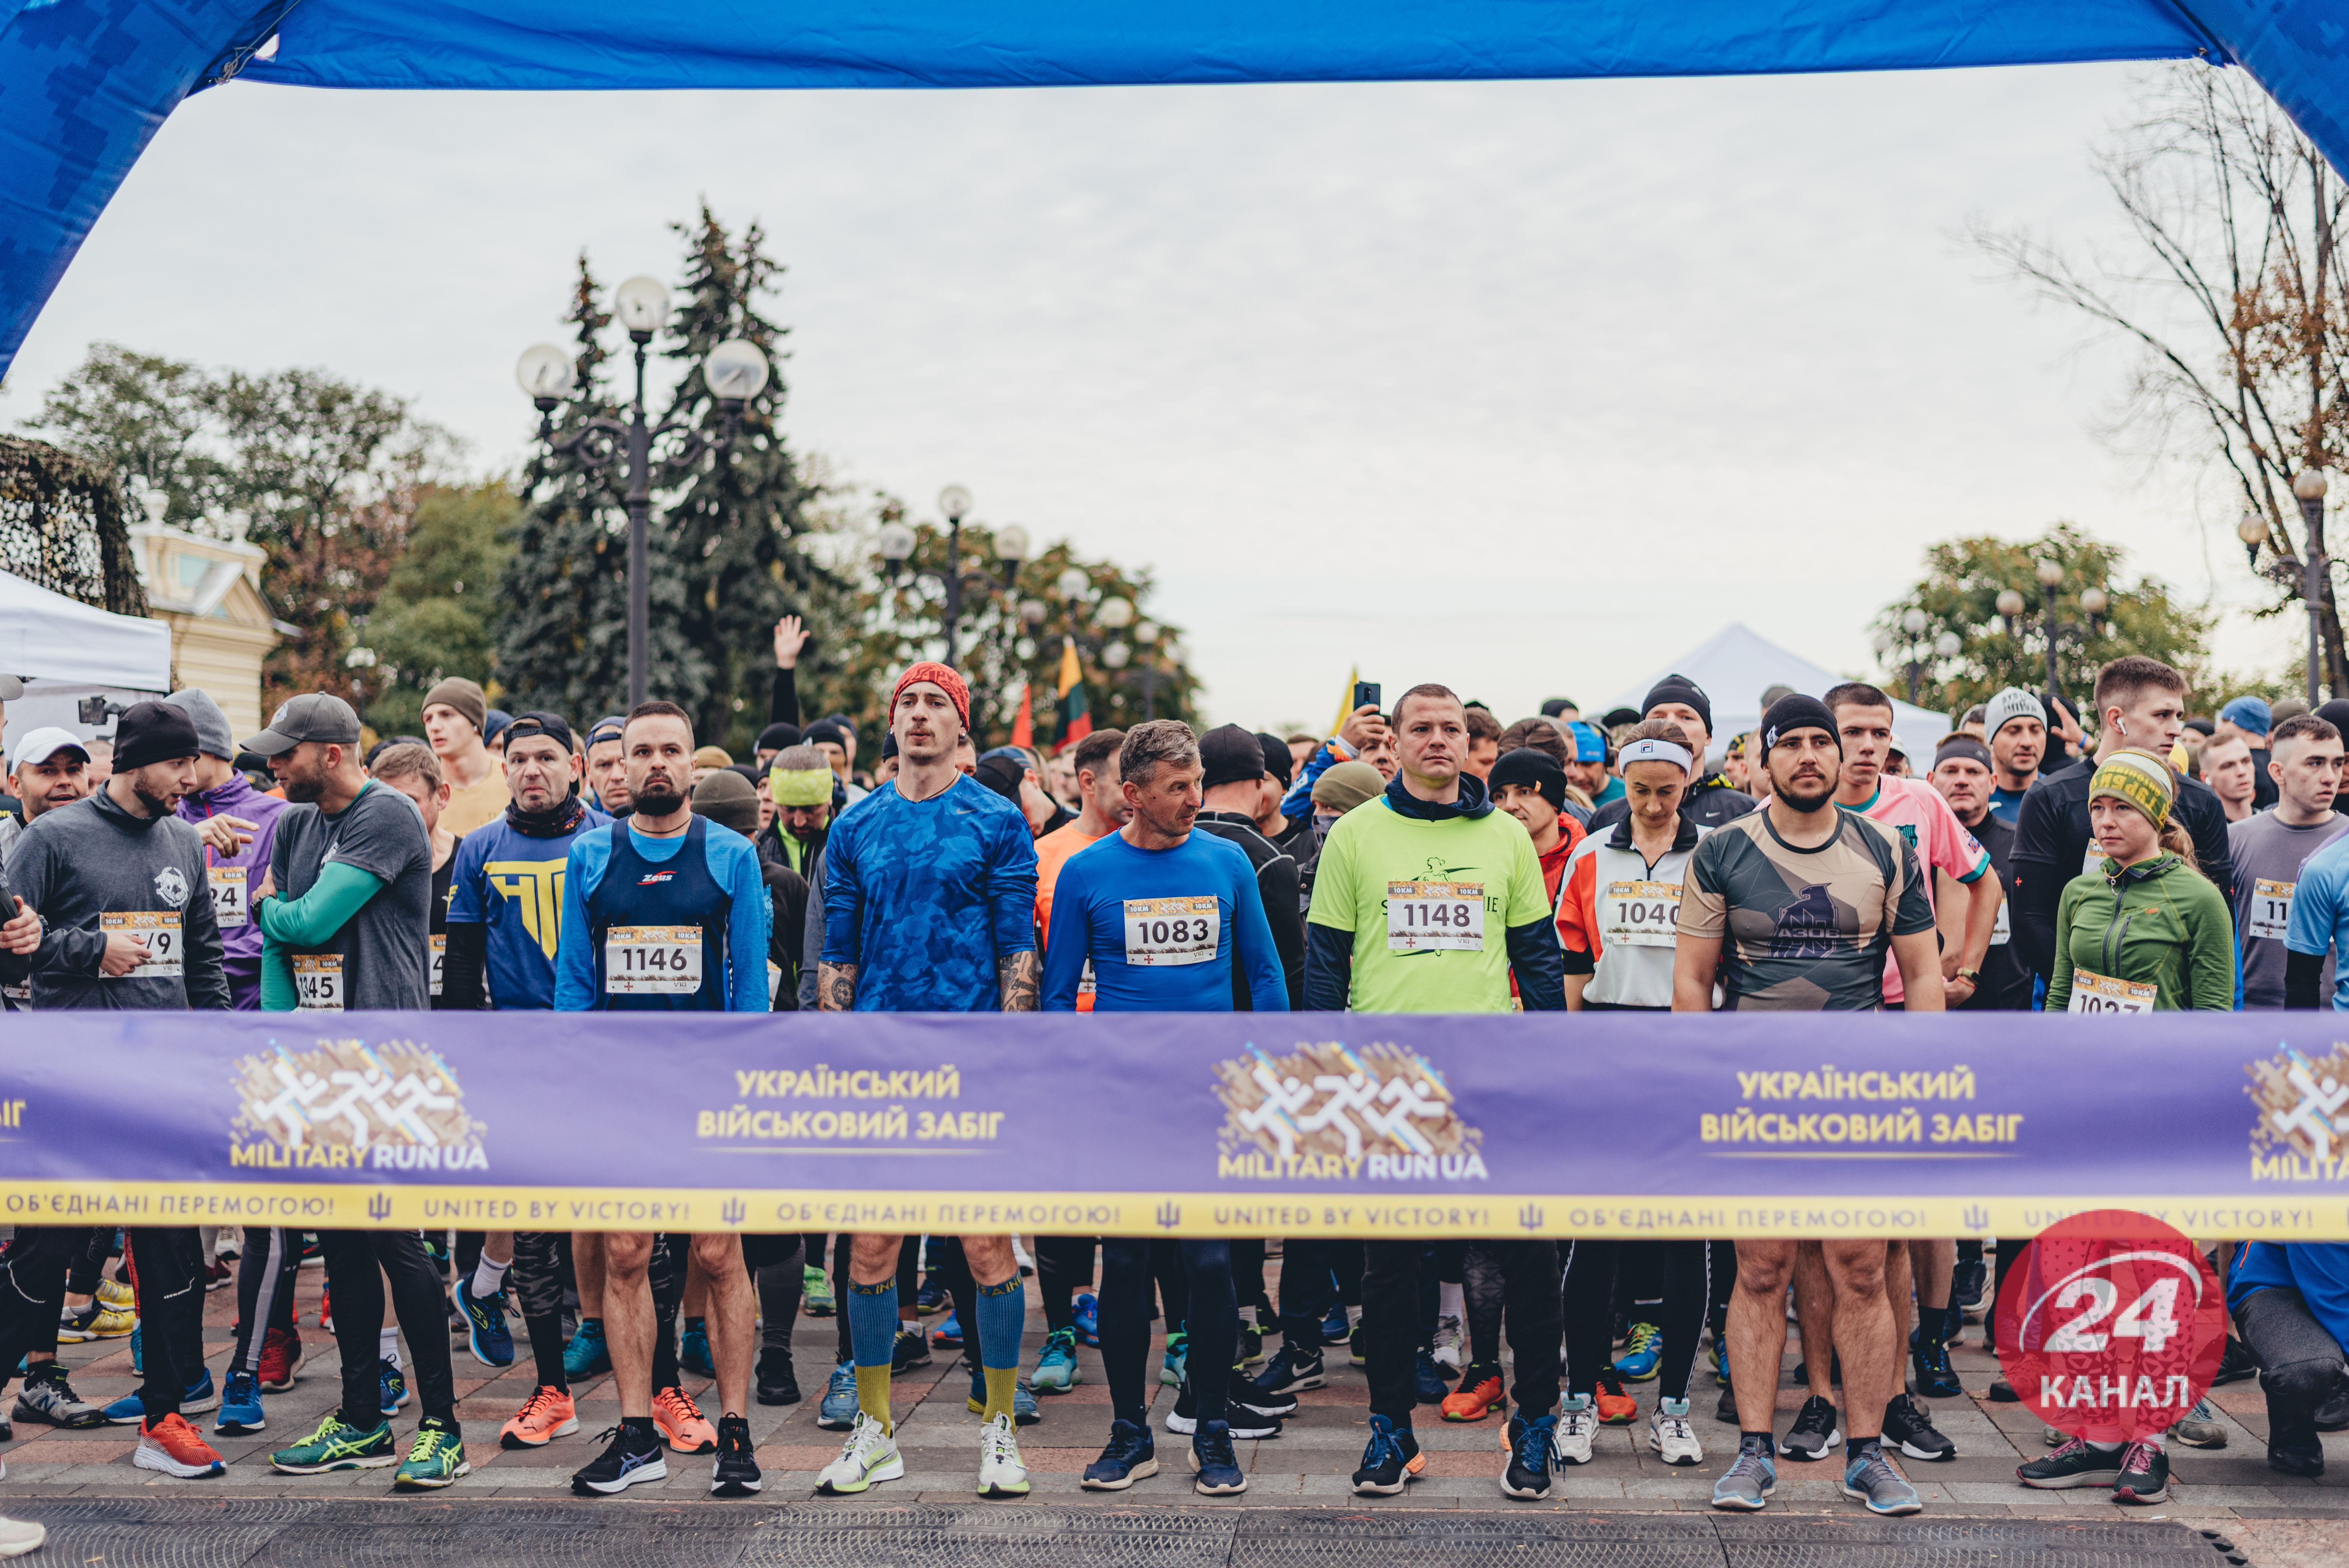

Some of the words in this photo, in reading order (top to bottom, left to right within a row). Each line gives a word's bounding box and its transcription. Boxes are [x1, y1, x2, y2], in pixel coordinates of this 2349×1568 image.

[642, 874, 673, 882] Zeus
[1404, 904, 1470, 927] 1148
[1138, 918, 1208, 944] 1083
[1778, 928, 1841, 938] АЗОВ
[622, 948, 687, 970] 1146
[300, 976, 333, 998] 1345
[2079, 976, 2092, 985] 10KM
[735, 1064, 960, 1099] УКРАЇНСЬКИЙ
[1737, 1065, 1975, 1100] УКРАЇНСЬКИЙ
[697, 1104, 908, 1139] ВІЙСЬКОВИЙ
[915, 1111, 1004, 1140] ЗАБІГ
[1701, 1107, 1921, 1143] ВІЙСЬКОВИЙ
[1930, 1114, 2023, 1143] ЗАБІГ
[231, 1144, 369, 1168] MILITARY
[1217, 1153, 1364, 1179] MILITARY
[160, 1195, 334, 1217] ПЕРЕМОГОЮ!
[423, 1199, 518, 1220] UNITED
[529, 1200, 558, 1220] BY
[570, 1200, 690, 1221] VICTORY!
[938, 1203, 1120, 1225] ПЕРЕМОГОЮ!
[1214, 1205, 1312, 1227] UNITED
[1323, 1206, 1353, 1226] BY
[1365, 1206, 1489, 1227] VICTORY!
[1737, 1208, 1926, 1229] ПЕРЕМОГОЮ!
[2024, 1210, 2125, 1228] UNITED
[2181, 1207, 2313, 1229] VICTORY!
